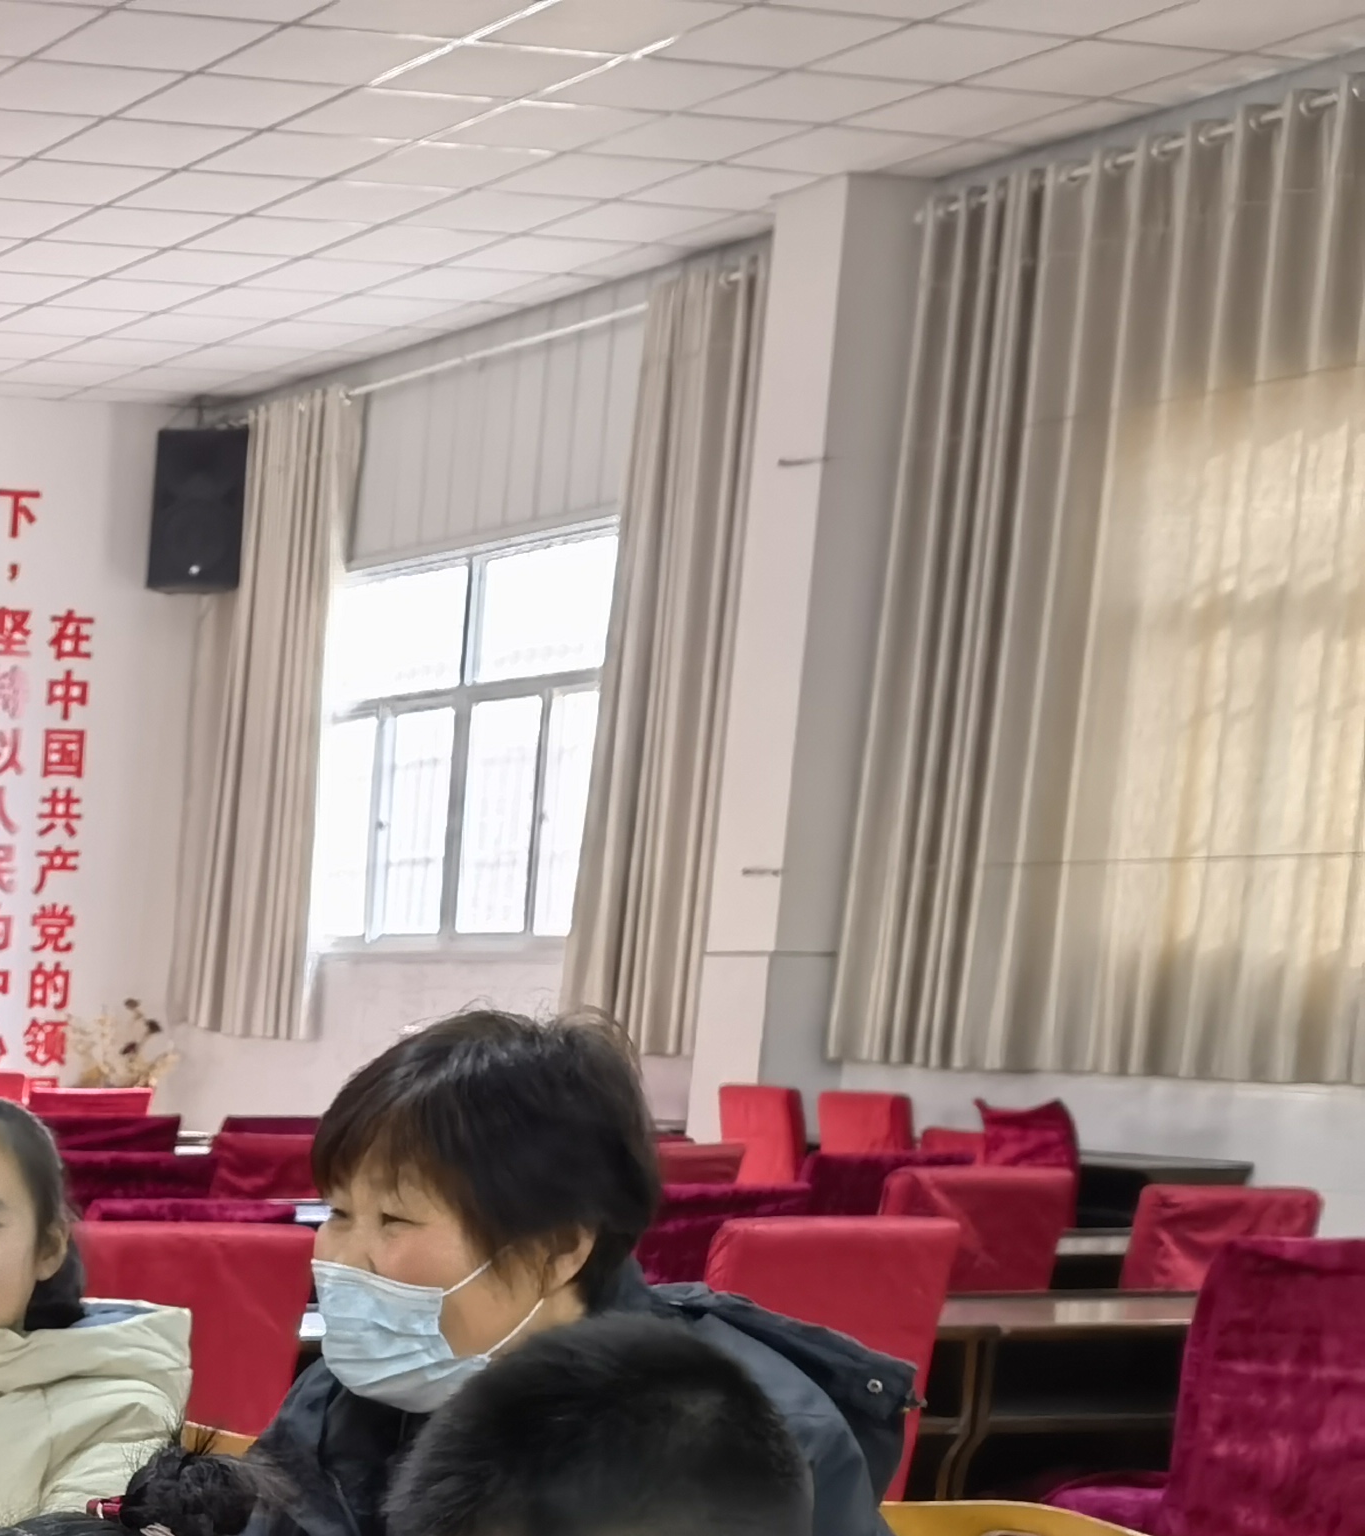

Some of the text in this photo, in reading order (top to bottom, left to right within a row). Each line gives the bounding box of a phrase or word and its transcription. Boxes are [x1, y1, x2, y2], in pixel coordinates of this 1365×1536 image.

[21, 608, 95, 1088] 在中国共产党的领
